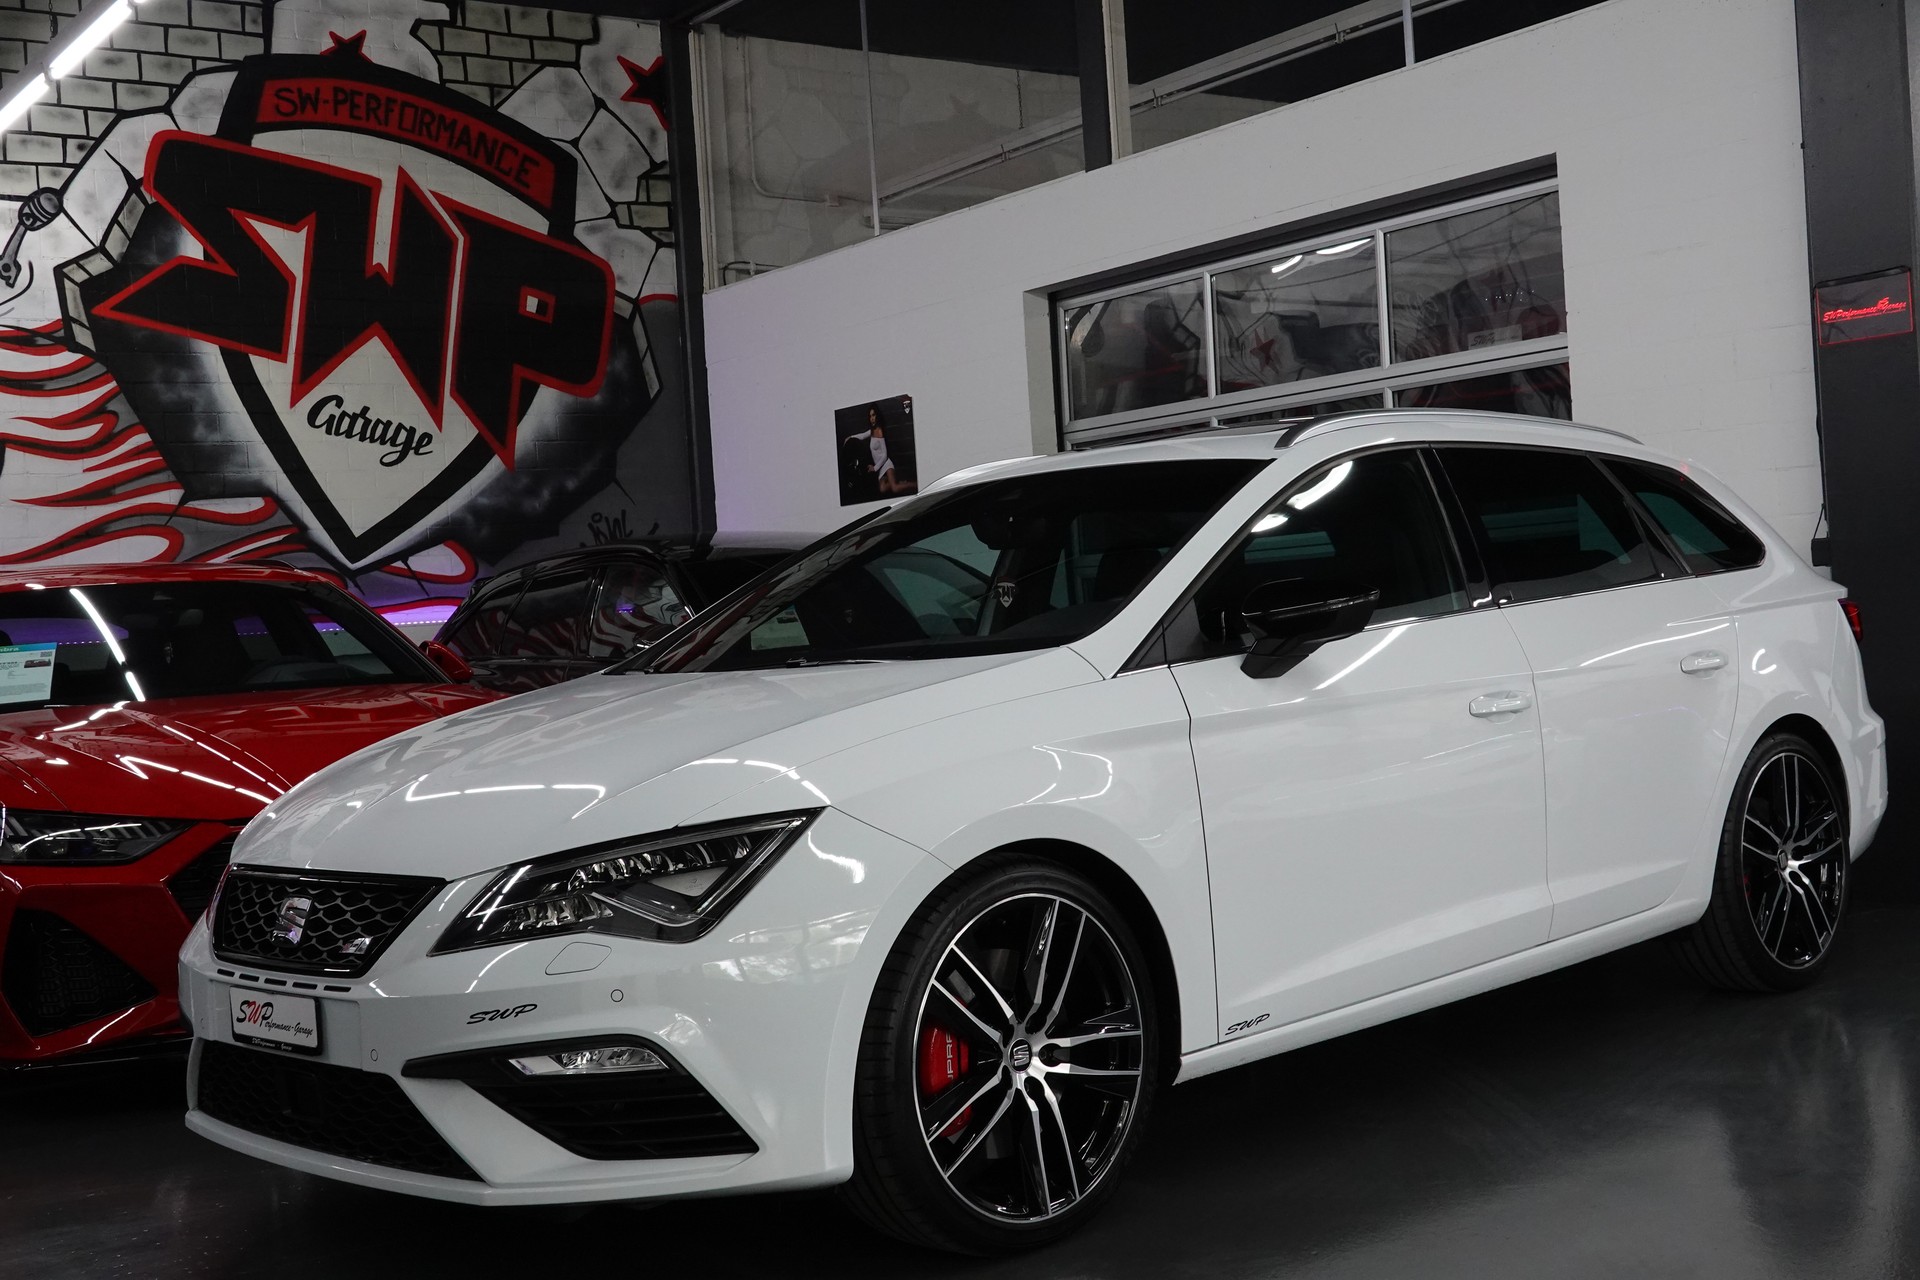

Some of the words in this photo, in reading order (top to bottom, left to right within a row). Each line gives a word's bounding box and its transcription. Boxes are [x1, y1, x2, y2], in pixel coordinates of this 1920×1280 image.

[273, 86, 541, 190] SW-PERFORMANCE
[91, 130, 615, 472] SWP
[307, 394, 433, 467] Garage
[466, 1003, 538, 1025] SWP
[1224, 1013, 1270, 1036] SWP
